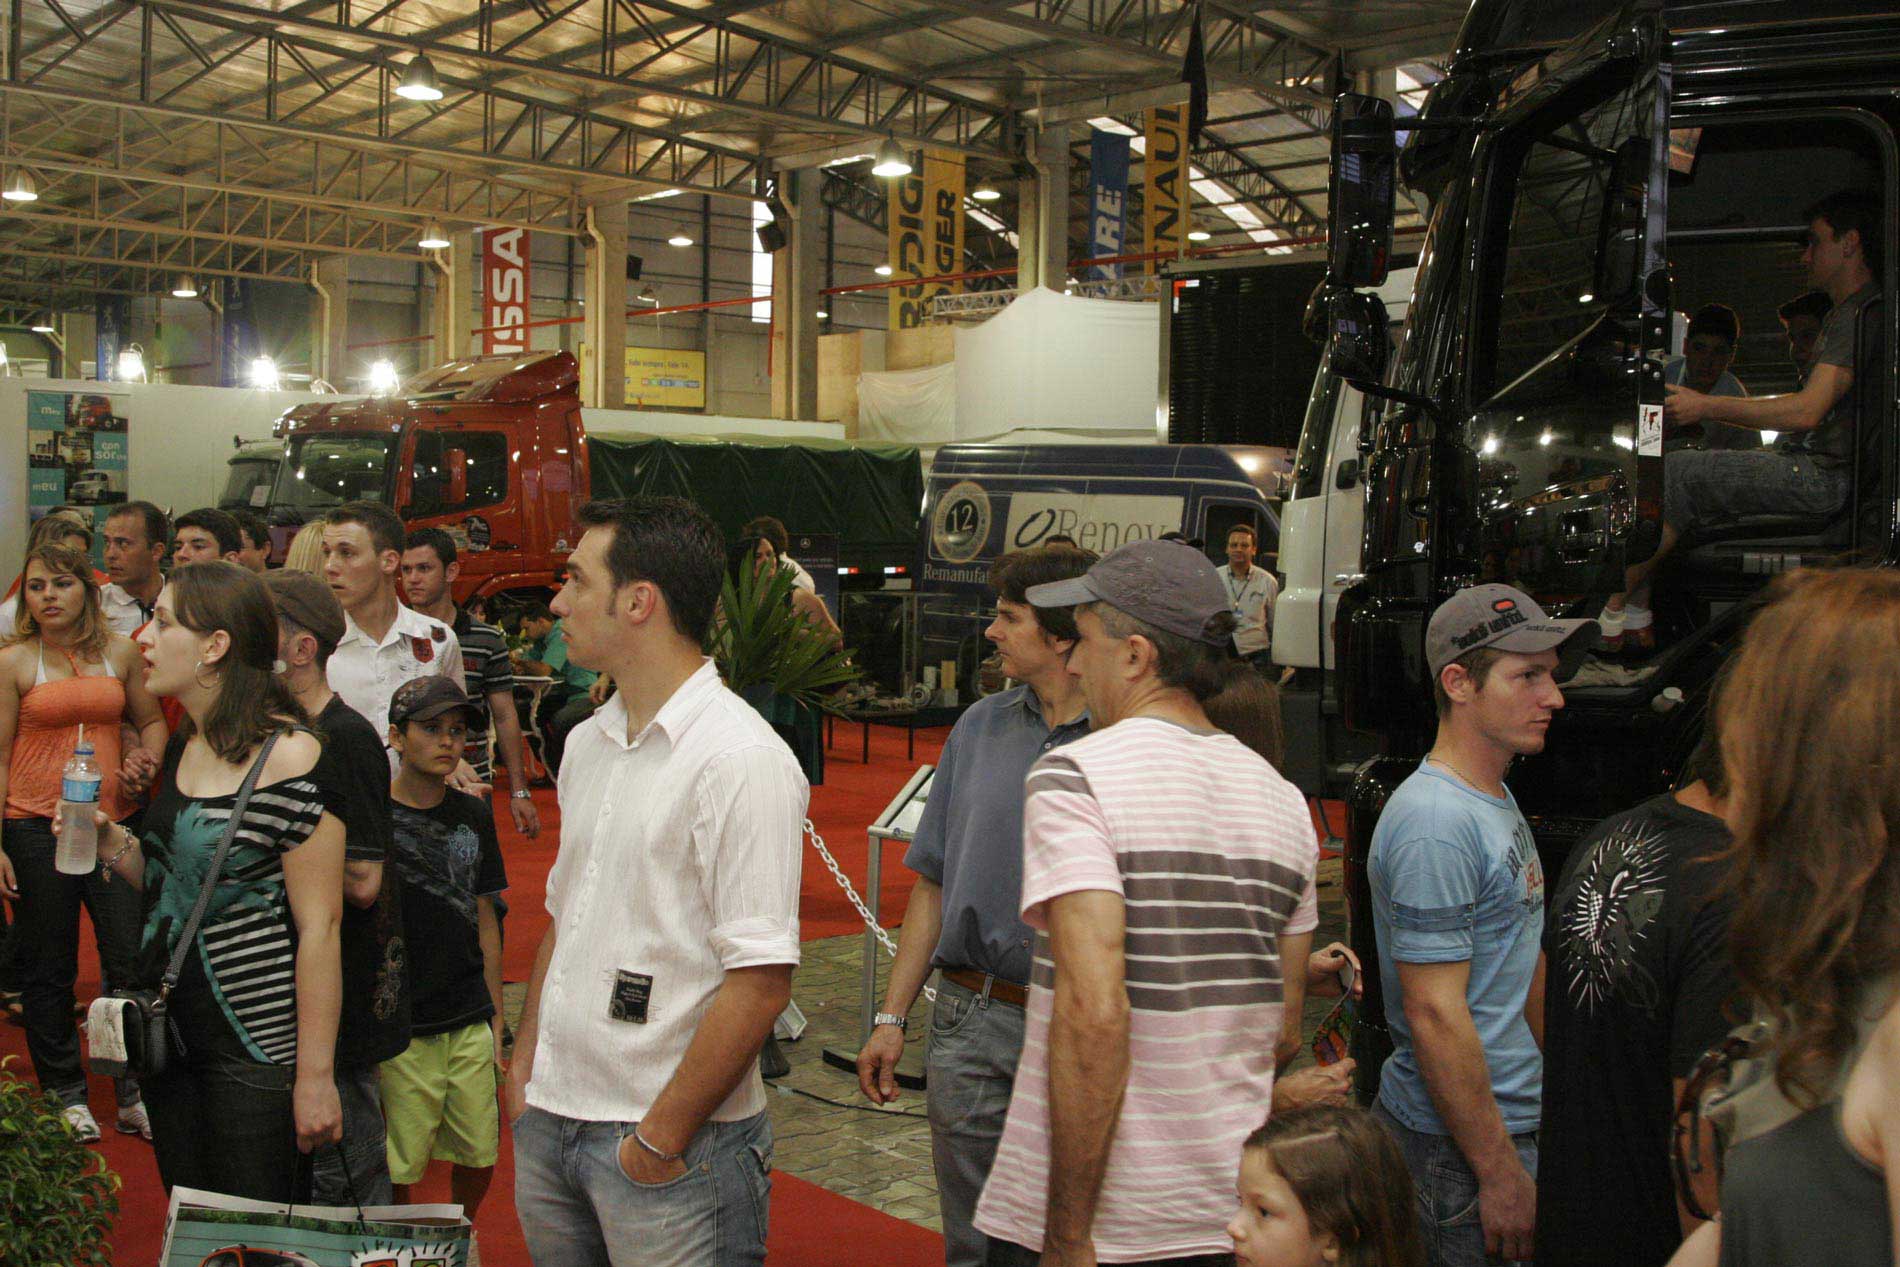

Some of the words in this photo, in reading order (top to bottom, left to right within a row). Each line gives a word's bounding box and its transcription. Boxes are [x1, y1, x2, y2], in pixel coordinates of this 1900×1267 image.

[1093, 184, 1122, 280] ARE
[1154, 105, 1180, 274] NAUL
[492, 228, 524, 355] ISSA
[951, 503, 973, 533] 12
[923, 563, 990, 583] Remanufa
